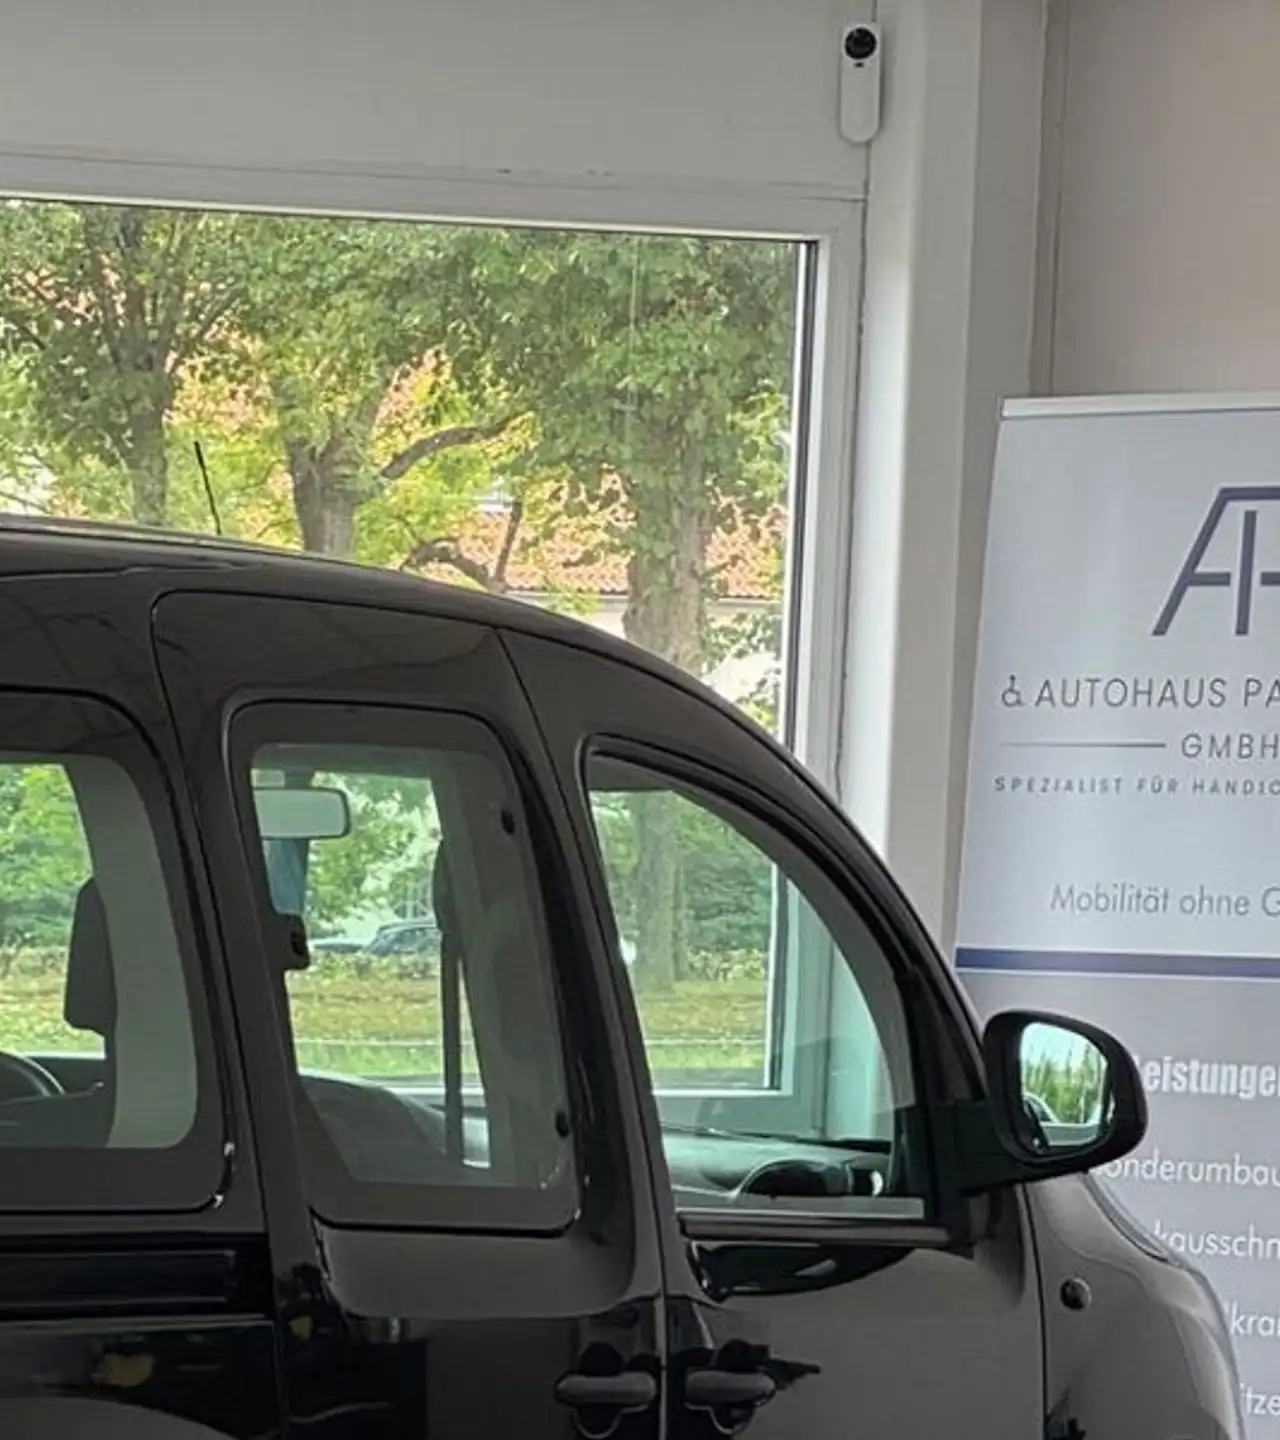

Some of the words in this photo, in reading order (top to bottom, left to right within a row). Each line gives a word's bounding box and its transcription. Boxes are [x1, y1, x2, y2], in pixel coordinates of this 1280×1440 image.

[1035, 677, 1227, 709] AUTOHAUS
[1181, 732, 1279, 759] GMBH
[994, 775, 1123, 795] SPEZIALIST
[1136, 775, 1179, 794] FÜR
[1049, 881, 1169, 914] Mobilität
[1180, 884, 1251, 917] ohne
[1134, 1054, 1280, 1101] eistunge
[1090, 1147, 1280, 1187] onderumbau
